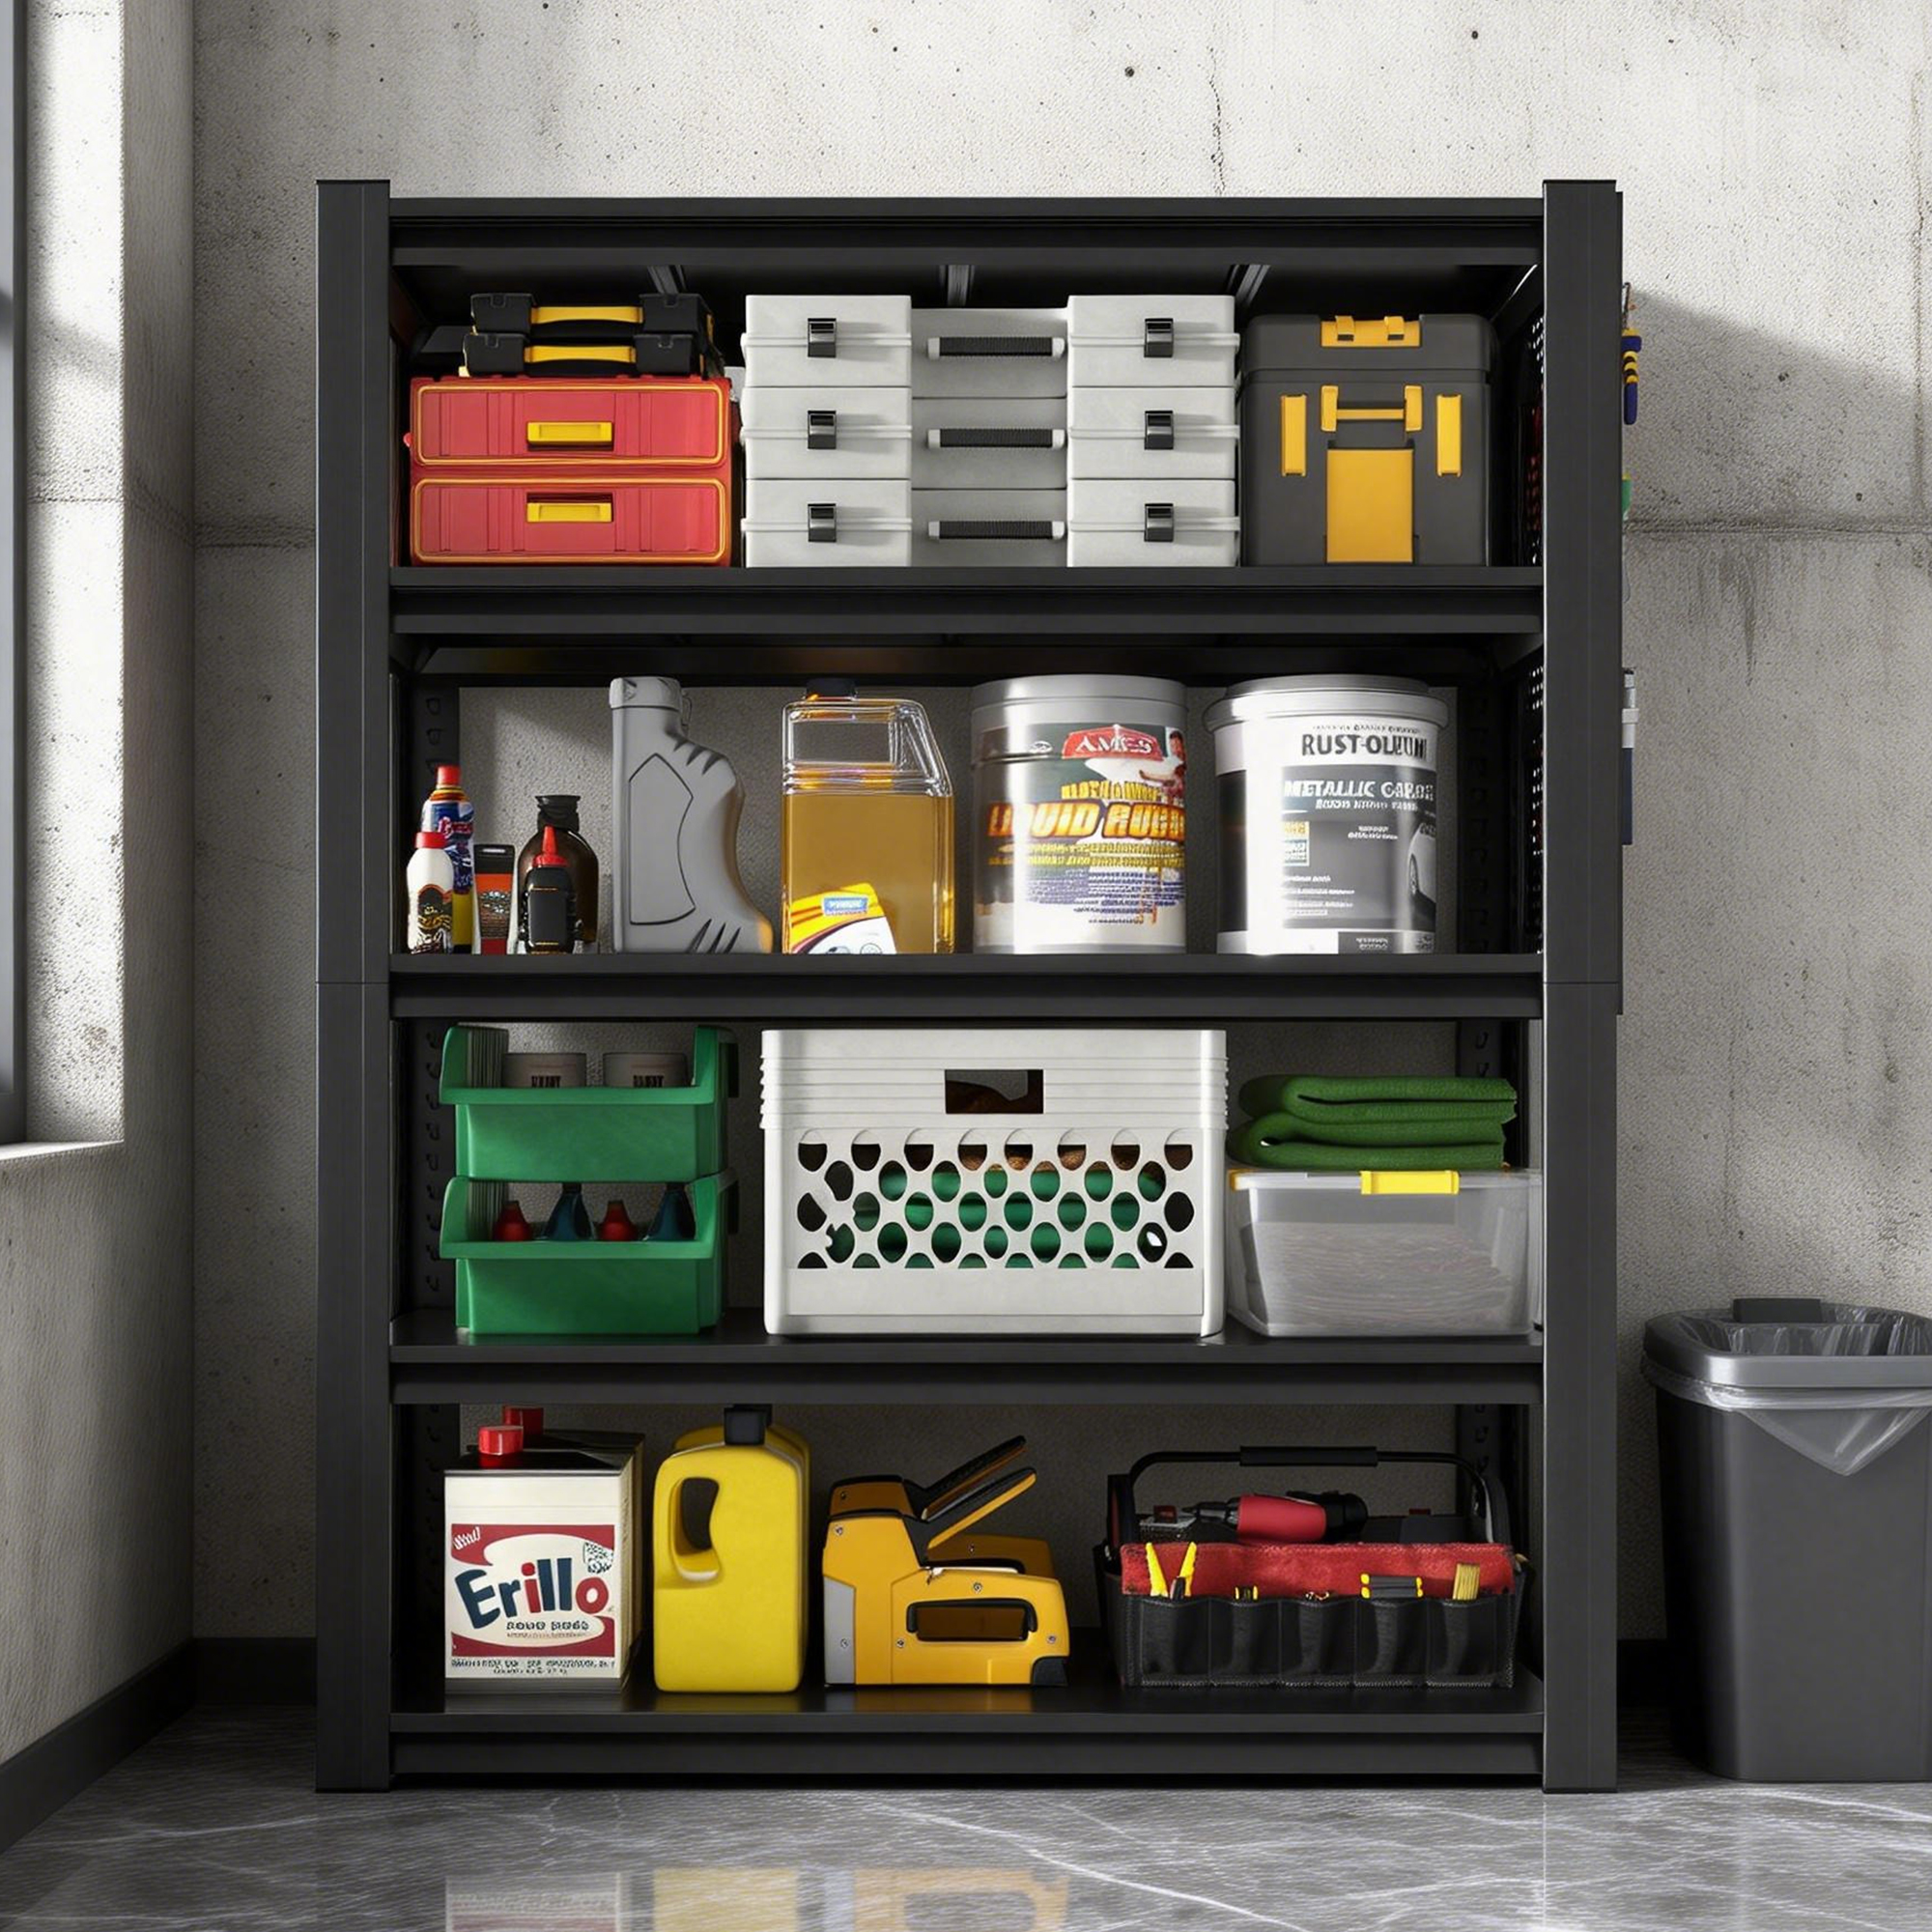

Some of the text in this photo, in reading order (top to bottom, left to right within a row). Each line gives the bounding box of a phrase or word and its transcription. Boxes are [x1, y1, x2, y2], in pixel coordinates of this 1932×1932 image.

[1284, 781, 1376, 798] METALLIC
[988, 802, 1100, 838] LIUID
[454, 1557, 610, 1630] Erillo
